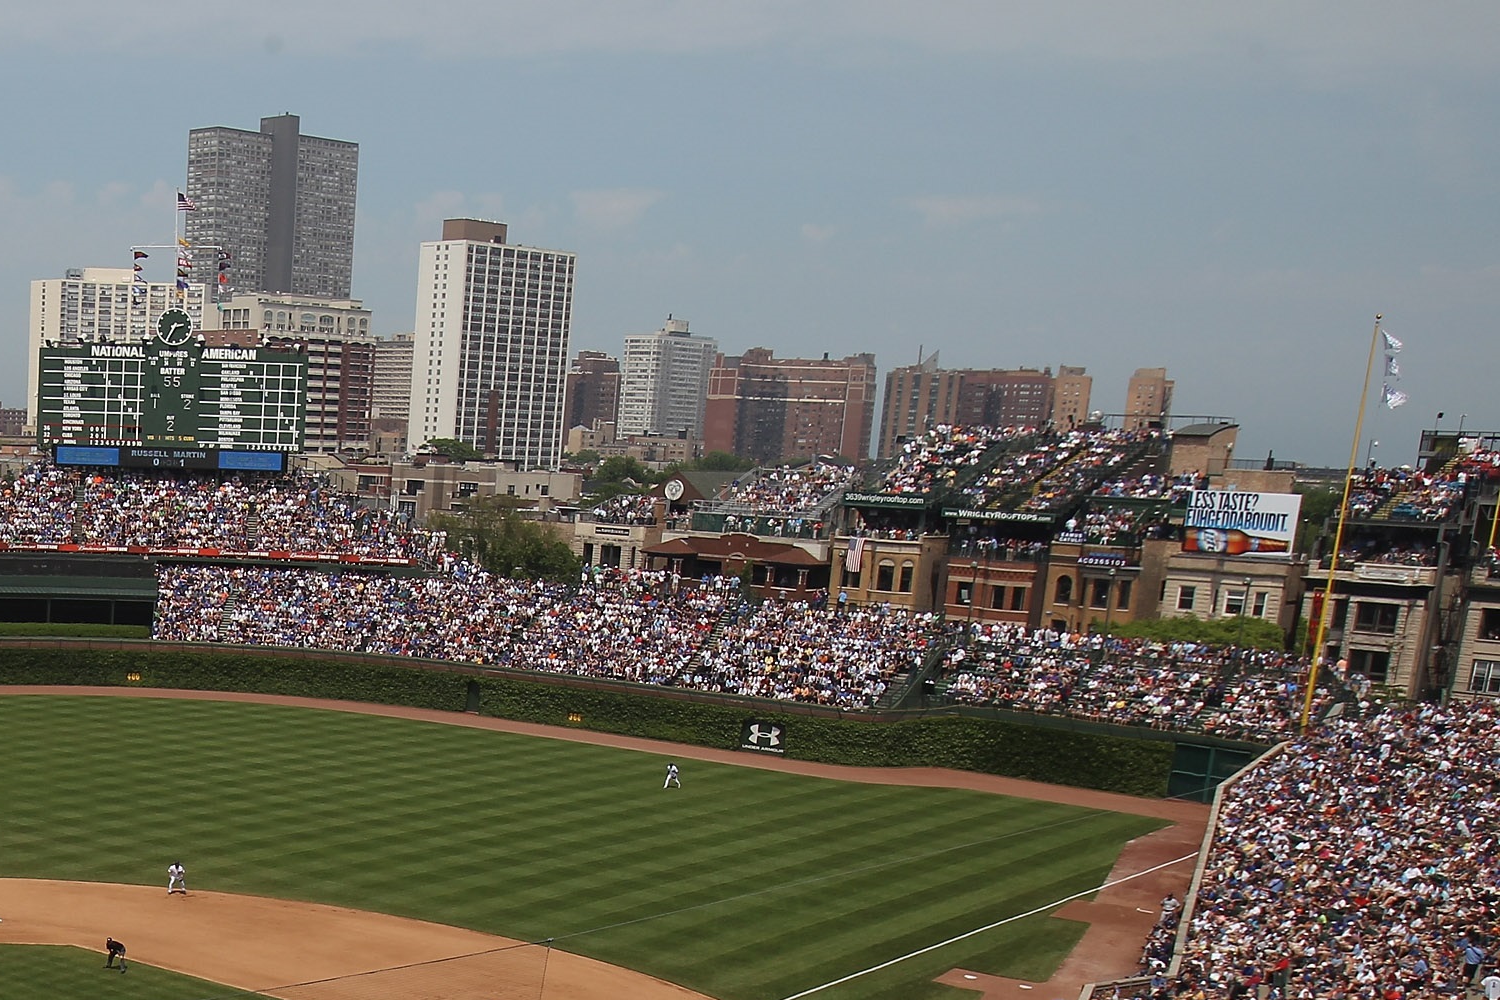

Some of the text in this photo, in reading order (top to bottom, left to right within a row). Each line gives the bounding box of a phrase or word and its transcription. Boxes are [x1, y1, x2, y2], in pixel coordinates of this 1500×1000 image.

[164, 376, 180, 387] 55
[183, 399, 191, 410] 2
[166, 421, 174, 431] 2
[173, 451, 206, 459] MARTIN
[845, 493, 924, 505] 3639wrigleyrooftop.com
[1189, 491, 1259, 511] LESS TASTE?
[1185, 509, 1289, 532] FUHGEDDABOUDIT.
[127, 672, 140, 680] 400
